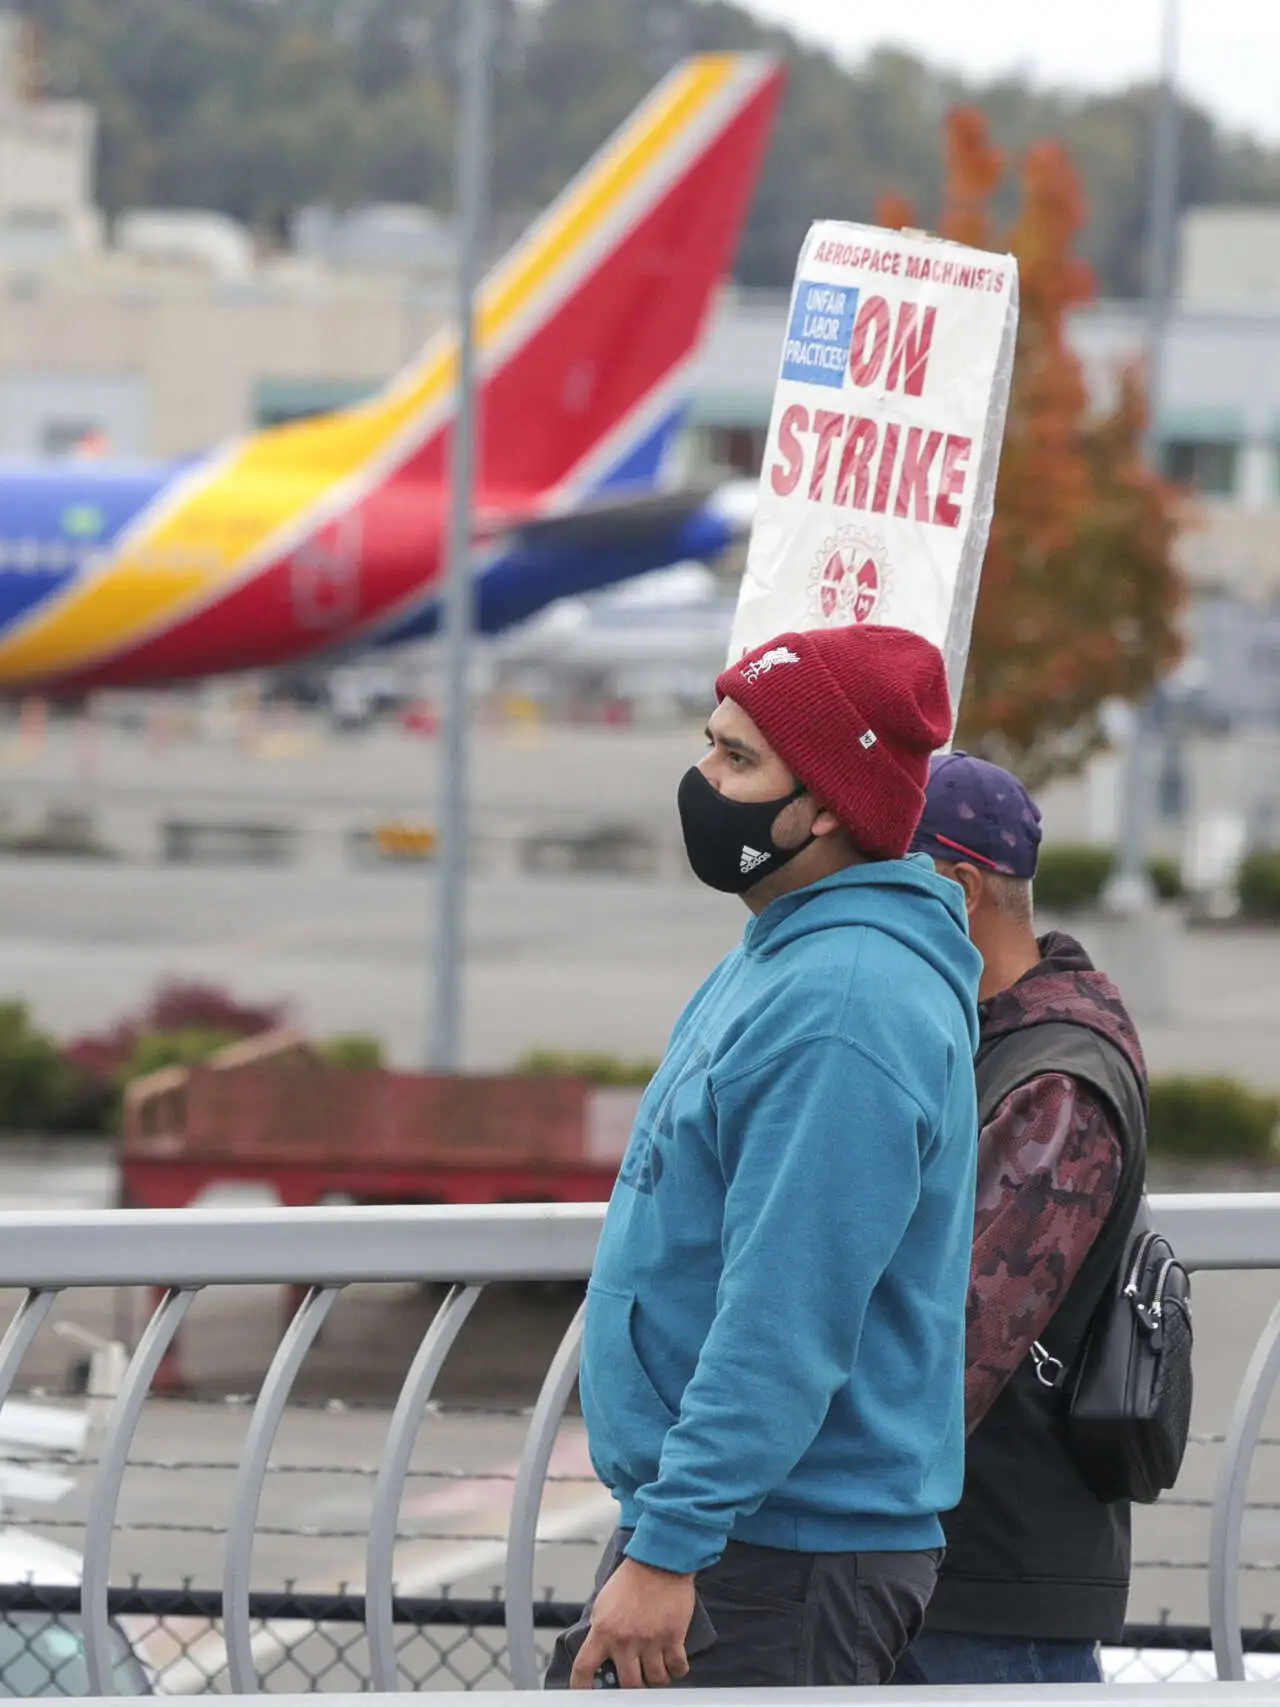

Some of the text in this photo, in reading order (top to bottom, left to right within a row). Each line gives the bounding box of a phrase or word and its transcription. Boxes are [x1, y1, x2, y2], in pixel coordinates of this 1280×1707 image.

[814, 239, 1005, 294] AEROSPACE MACHINISTS
[806, 286, 847, 316] UNFAIR
[802, 314, 841, 341] LABOR
[784, 339, 849, 372] PRACTICES!
[849, 295, 938, 397] ON
[771, 404, 973, 529] STRIKE
[741, 851, 771, 873] adidas
